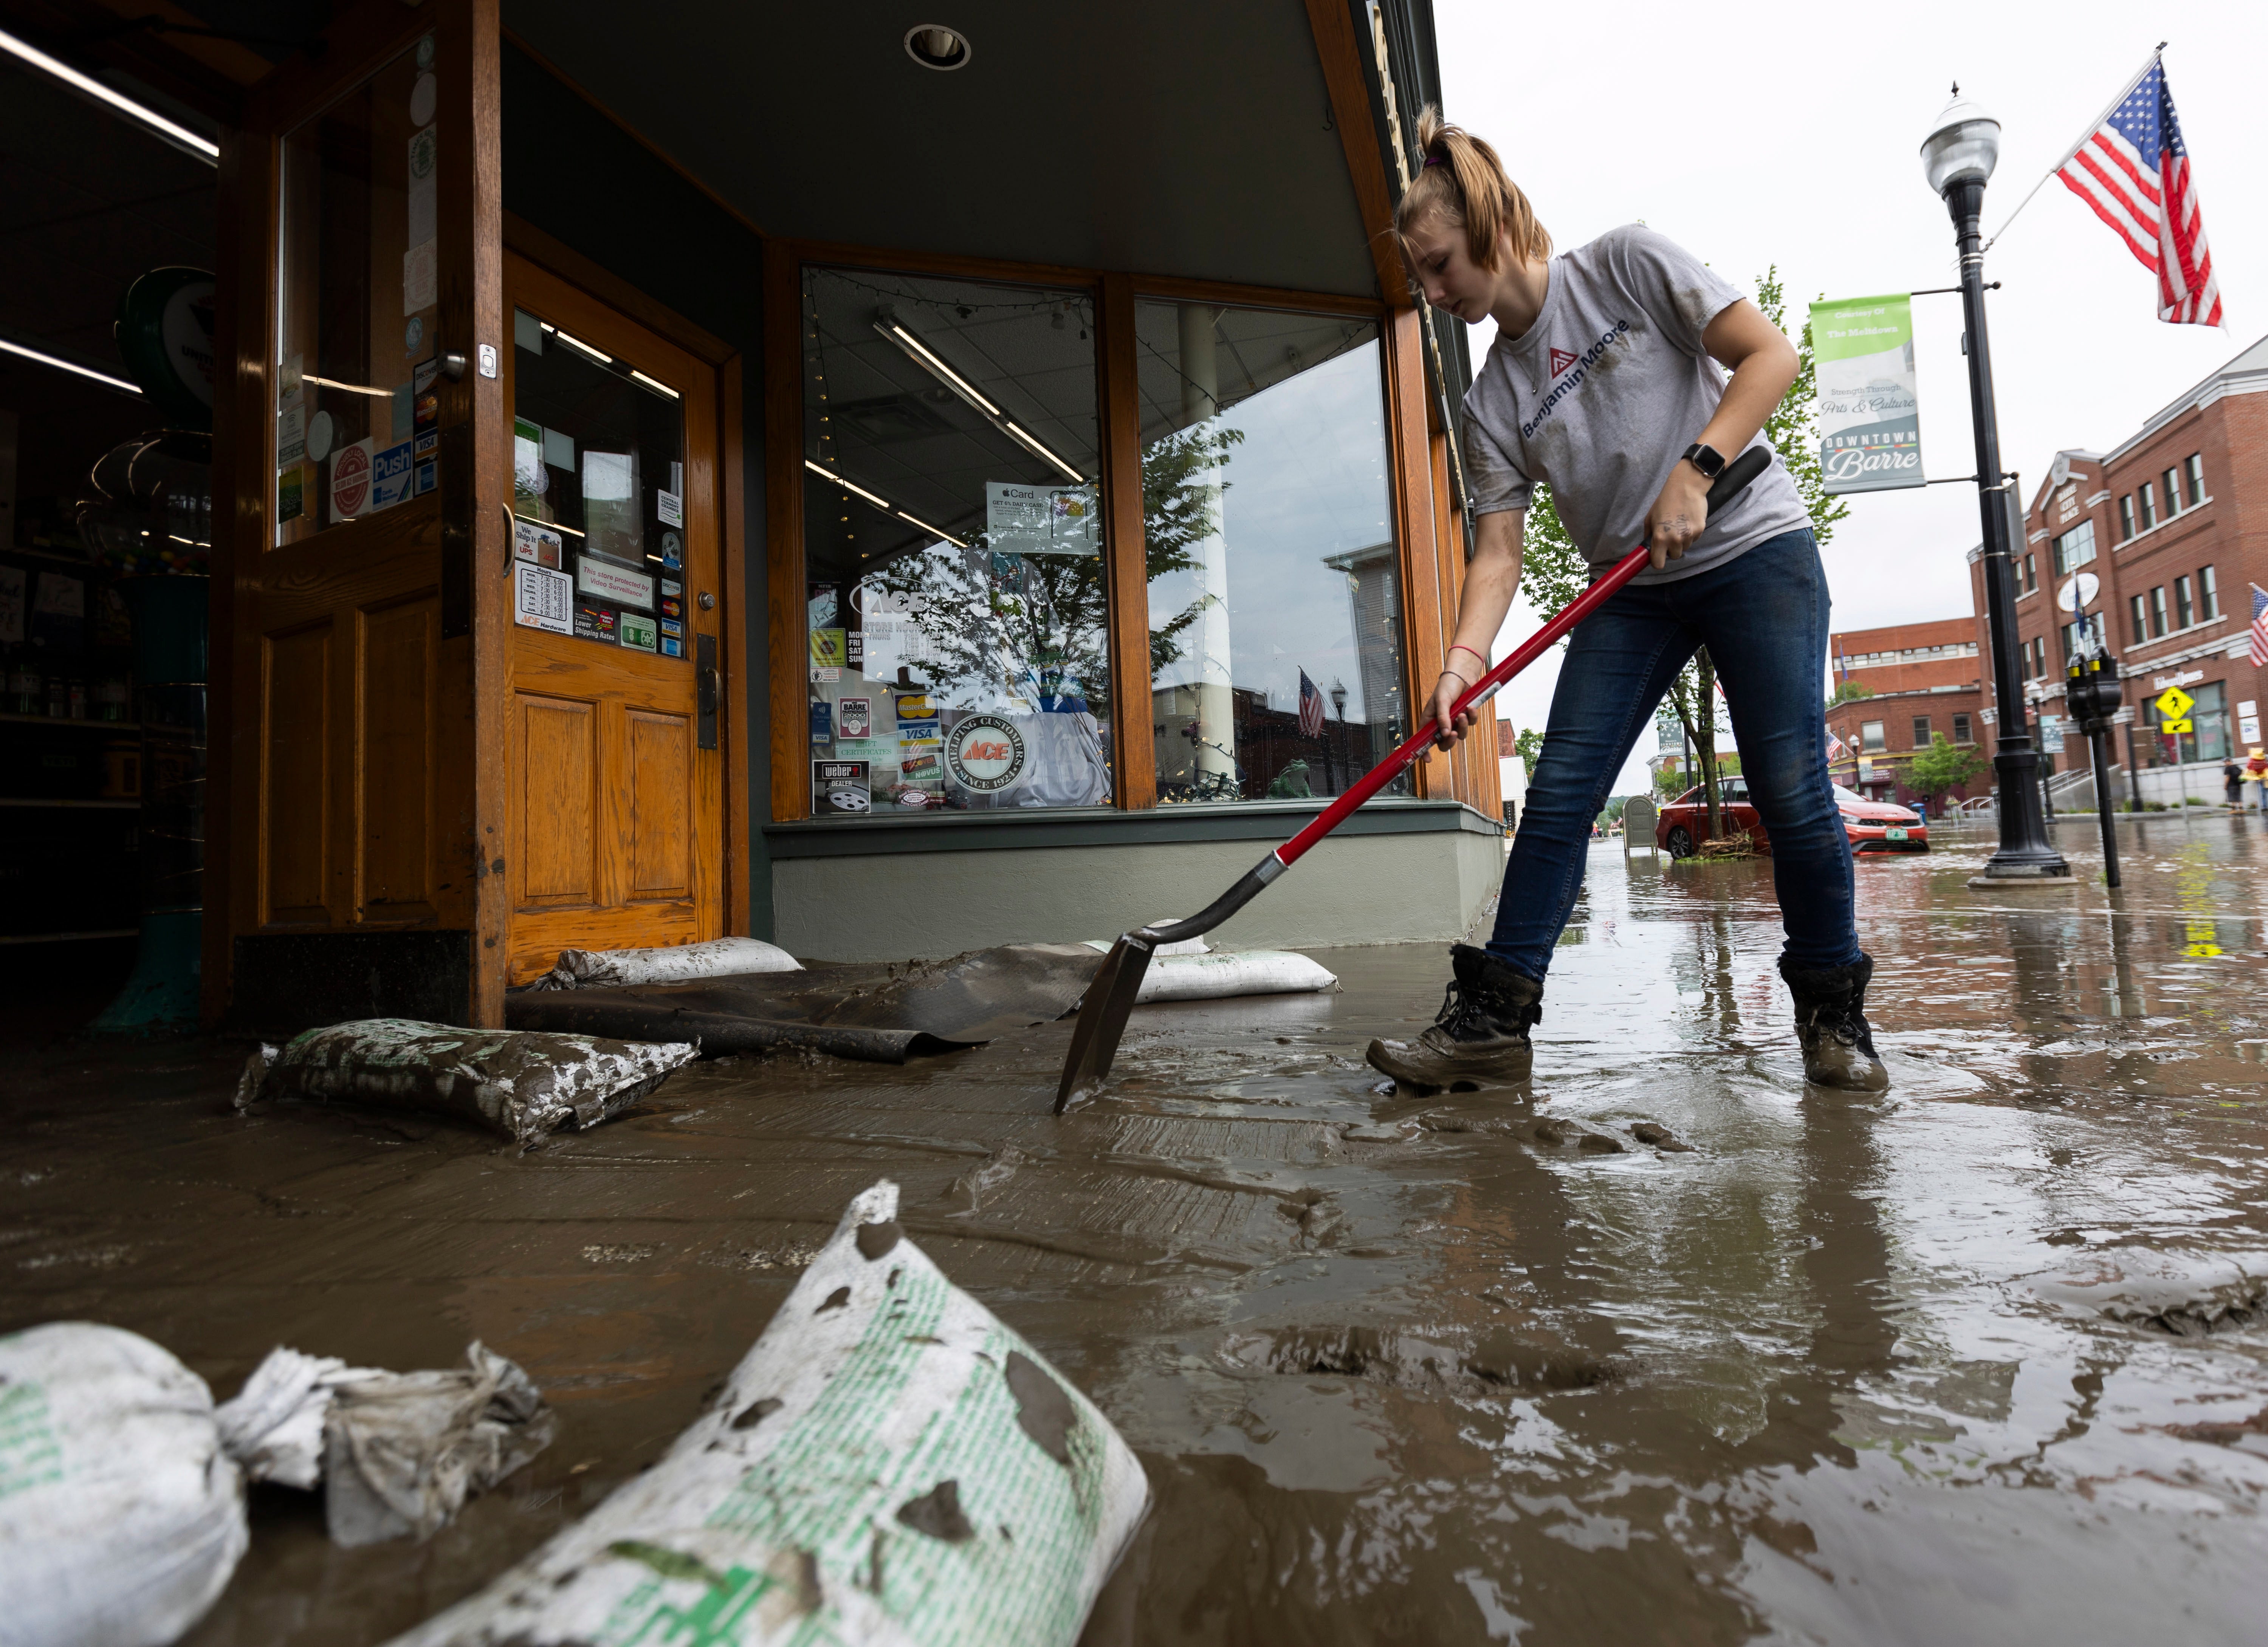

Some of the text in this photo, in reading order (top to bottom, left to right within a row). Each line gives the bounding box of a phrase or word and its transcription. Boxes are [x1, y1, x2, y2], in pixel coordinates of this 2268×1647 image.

[1834, 310, 1872, 319] Courtesy
[1827, 325, 1899, 339] The Meltdown
[1523, 319, 1630, 438] Benjamin Moore
[1831, 384, 1901, 399] Strength Through
[1821, 397, 1916, 416] Arts & Culture
[420, 437, 434, 451] VISA
[1825, 431, 1917, 448] DOWNTOWN
[336, 449, 366, 476] PROUDLY LOCAL
[375, 448, 410, 481] Push
[1823, 449, 1920, 482] Barre
[1010, 489, 1034, 499] Card
[2056, 483, 2077, 503] BARRE
[661, 496, 679, 505] CENTRAL
[661, 499, 679, 509] VERMONT
[2059, 496, 2076, 512] CITY
[661, 504, 679, 513] CHAMBER
[2059, 505, 2079, 524] PLACE
[516, 531, 530, 543] Ship
[521, 526, 531, 535] We
[520, 546, 533, 556] UPS
[537, 567, 552, 575] Hours
[584, 566, 649, 592] This store protected by
[590, 577, 643, 598] Video Surveillance
[663, 582, 680, 591] DISCOVER
[870, 588, 926, 612] ACE
[520, 614, 541, 626] ACE
[575, 619, 592, 628] Lower
[863, 622, 926, 631] STORE HOURS
[540, 622, 566, 632] Hardware
[575, 626, 615, 641] Shipping Rates
[665, 623, 677, 632] VISA
[905, 729, 933, 739] VISA
[950, 717, 1024, 766] HELPING CUSTOMERS
[962, 739, 1010, 760] ACE
[1660, 745, 1683, 754] Barre
[825, 764, 852, 777] weber
[902, 757, 934, 771] DISCOVER
[915, 767, 940, 779] NOVUS
[957, 770, 1015, 789] SINCE 1924
[899, 791, 907, 799] Proud
